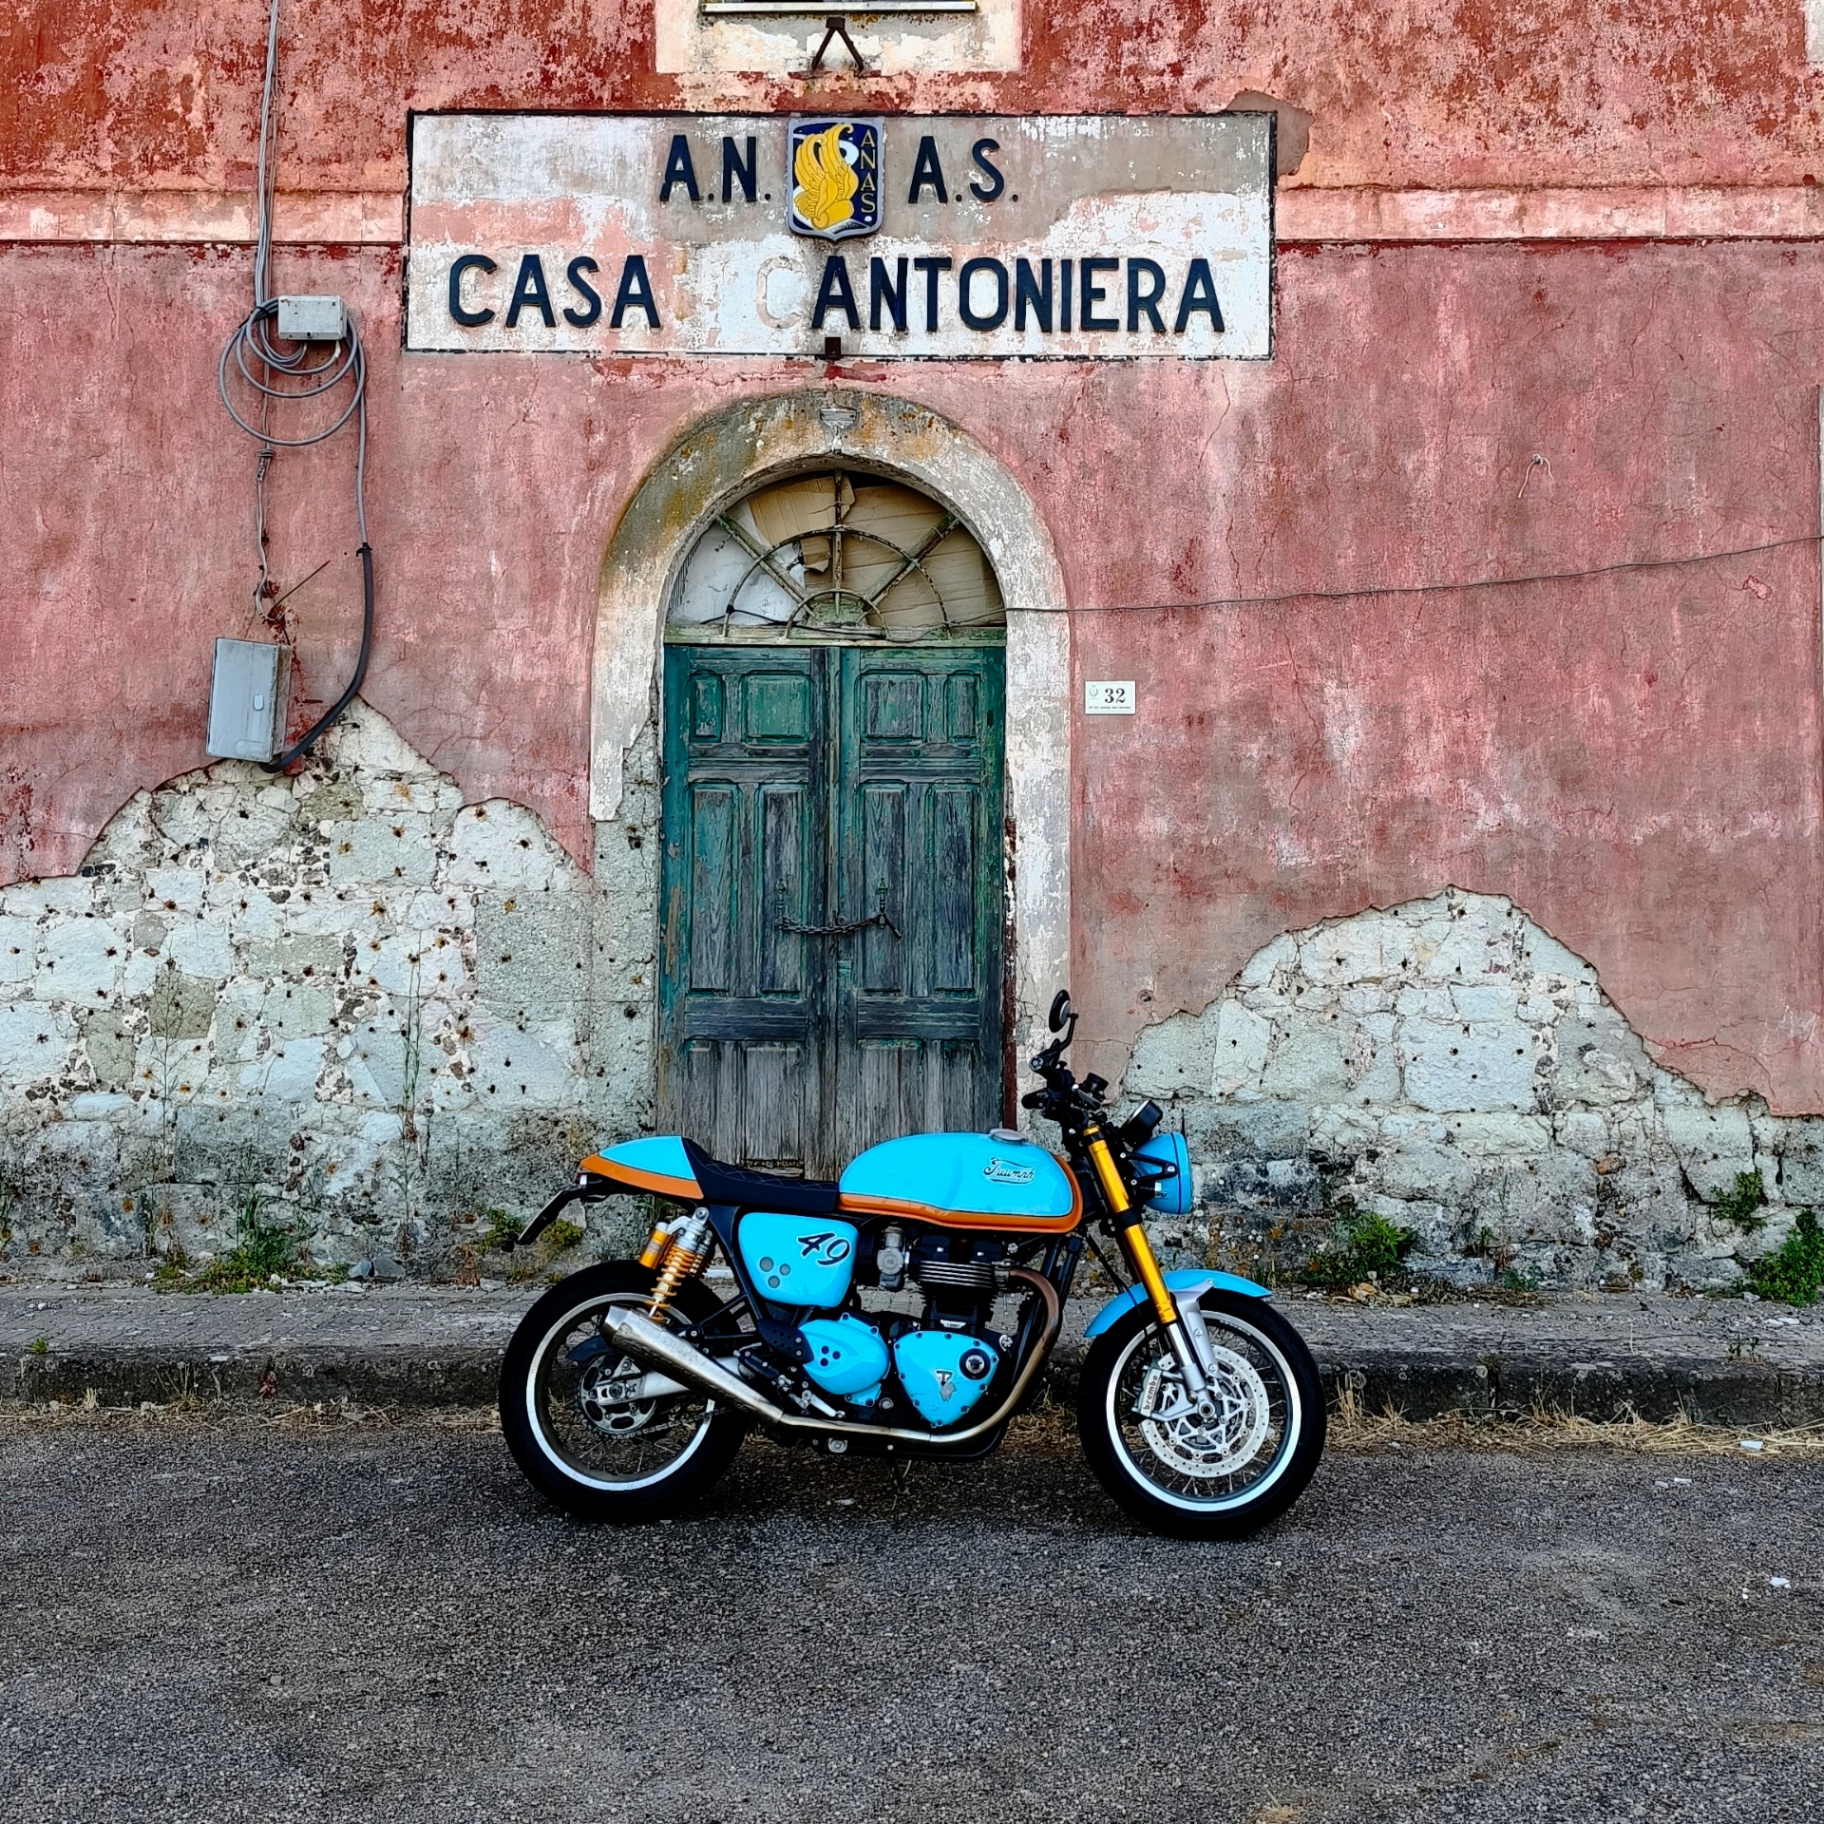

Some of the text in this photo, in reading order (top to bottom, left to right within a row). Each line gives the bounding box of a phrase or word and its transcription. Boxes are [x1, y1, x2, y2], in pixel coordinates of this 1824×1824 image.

[659, 134, 1019, 204] A.N. A.S.
[860, 129, 877, 214] ANAS
[449, 253, 662, 329] CASA
[1104, 687, 1126, 704] 32
[983, 1156, 1035, 1182] Triumph
[797, 1232, 850, 1266] 49
[1143, 1375, 1158, 1410] brembo
